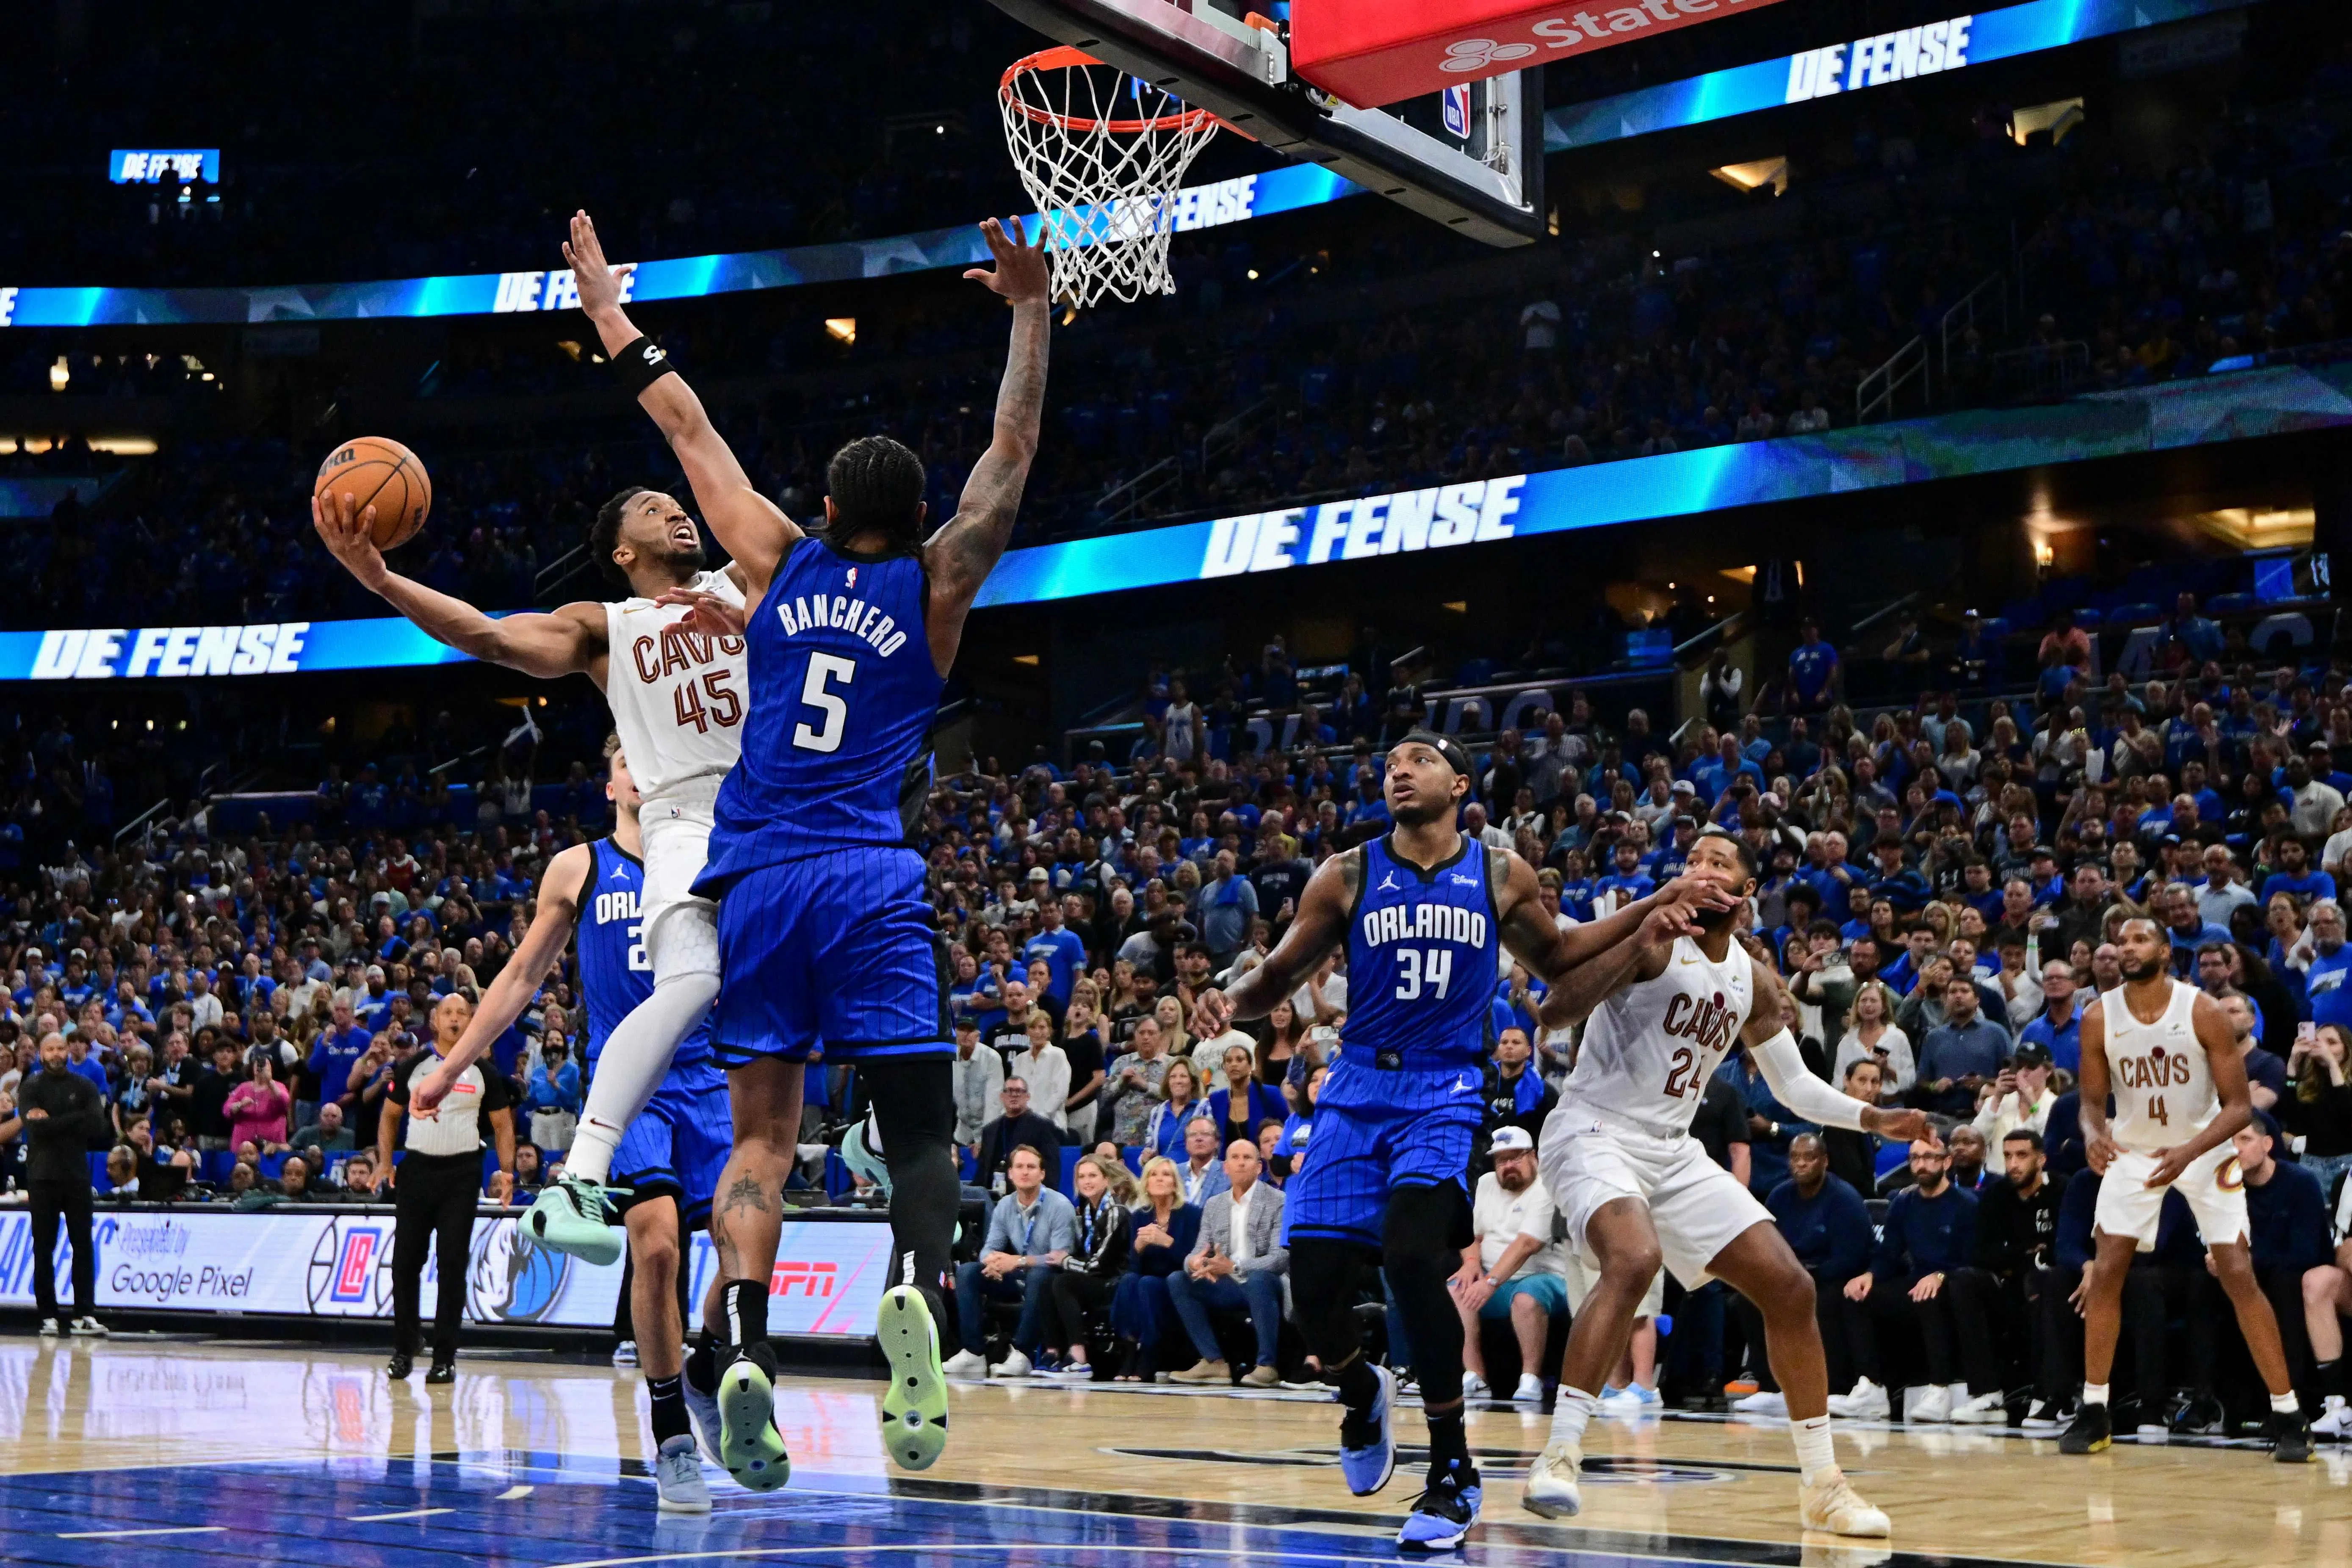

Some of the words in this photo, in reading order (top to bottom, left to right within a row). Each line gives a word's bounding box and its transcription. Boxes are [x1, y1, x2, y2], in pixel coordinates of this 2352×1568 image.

[1785, 43, 1846, 104] DE
[1848, 15, 1972, 90] FENSE
[1447, 105, 1460, 128] NBA
[493, 271, 545, 312] DE
[643, 345, 664, 365] 5
[1201, 507, 1306, 578] DE
[1306, 474, 1526, 565] FENSE
[777, 594, 906, 657] BANCHERO
[30, 629, 128, 679] DE
[126, 622, 310, 678] FENSE
[674, 669, 742, 734] 45
[792, 651, 856, 753] 5
[1450, 873, 1478, 888] Disney
[1364, 904, 1486, 949] ORLANDO
[1396, 949, 1452, 999] 34
[1663, 993, 1738, 1052] CAVS
[2119, 1052, 2190, 1088] CAVS
[2148, 1095, 2168, 1126] 4
[112, 1264, 191, 1302] Google
[198, 1267, 253, 1296] Pixel
